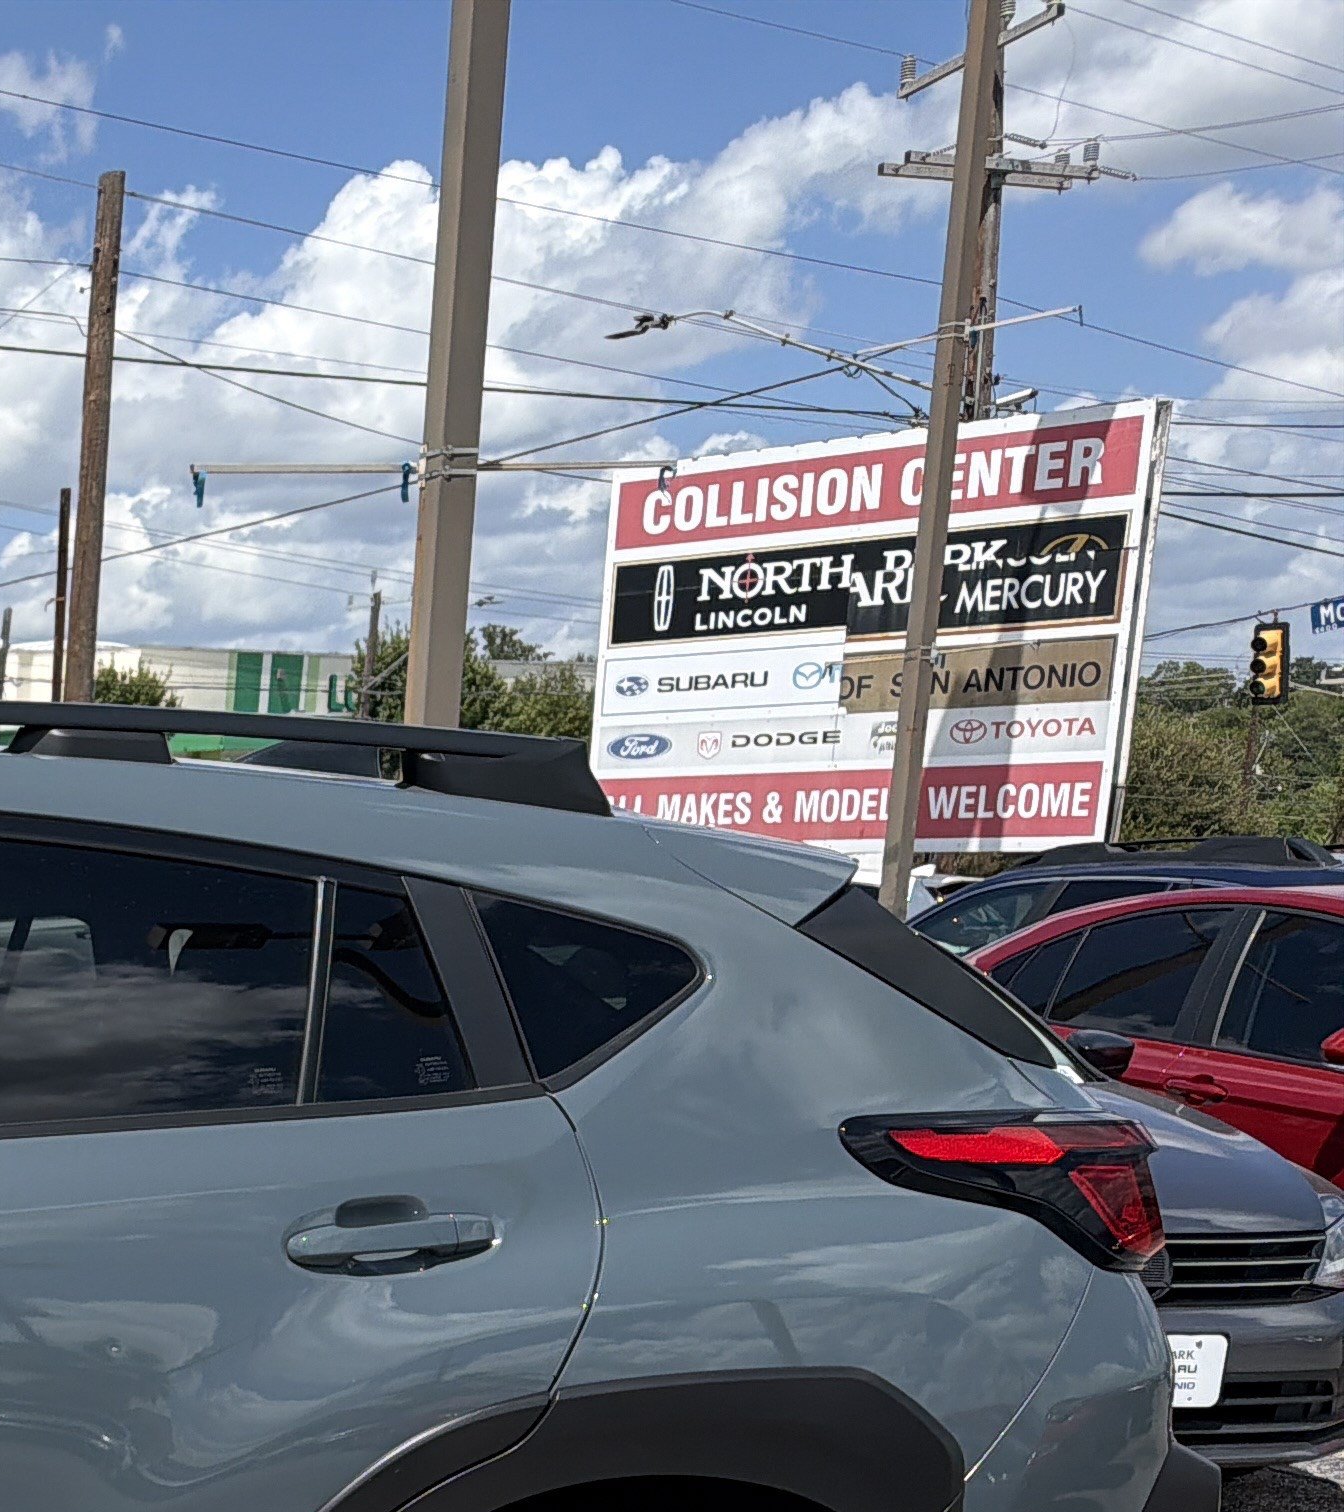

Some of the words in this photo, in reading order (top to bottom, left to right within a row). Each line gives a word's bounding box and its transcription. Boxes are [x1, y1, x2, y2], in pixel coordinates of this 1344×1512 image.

[642, 463, 883, 535] COLLISION
[697, 554, 854, 602] NORTH
[953, 569, 1108, 614] MERCURY
[694, 604, 807, 631] LINCOLN
[657, 670, 769, 693] SUBARU
[839, 675, 873, 699] OF
[890, 670, 950, 697] SN
[962, 661, 1102, 693] ANTONIO
[731, 730, 842, 748] DODGE
[991, 717, 1096, 739] TOYOTA
[657, 790, 752, 827] MAKES
[762, 791, 783, 824] &
[794, 787, 889, 823] MODEL
[928, 782, 1092, 820] WELCOME
